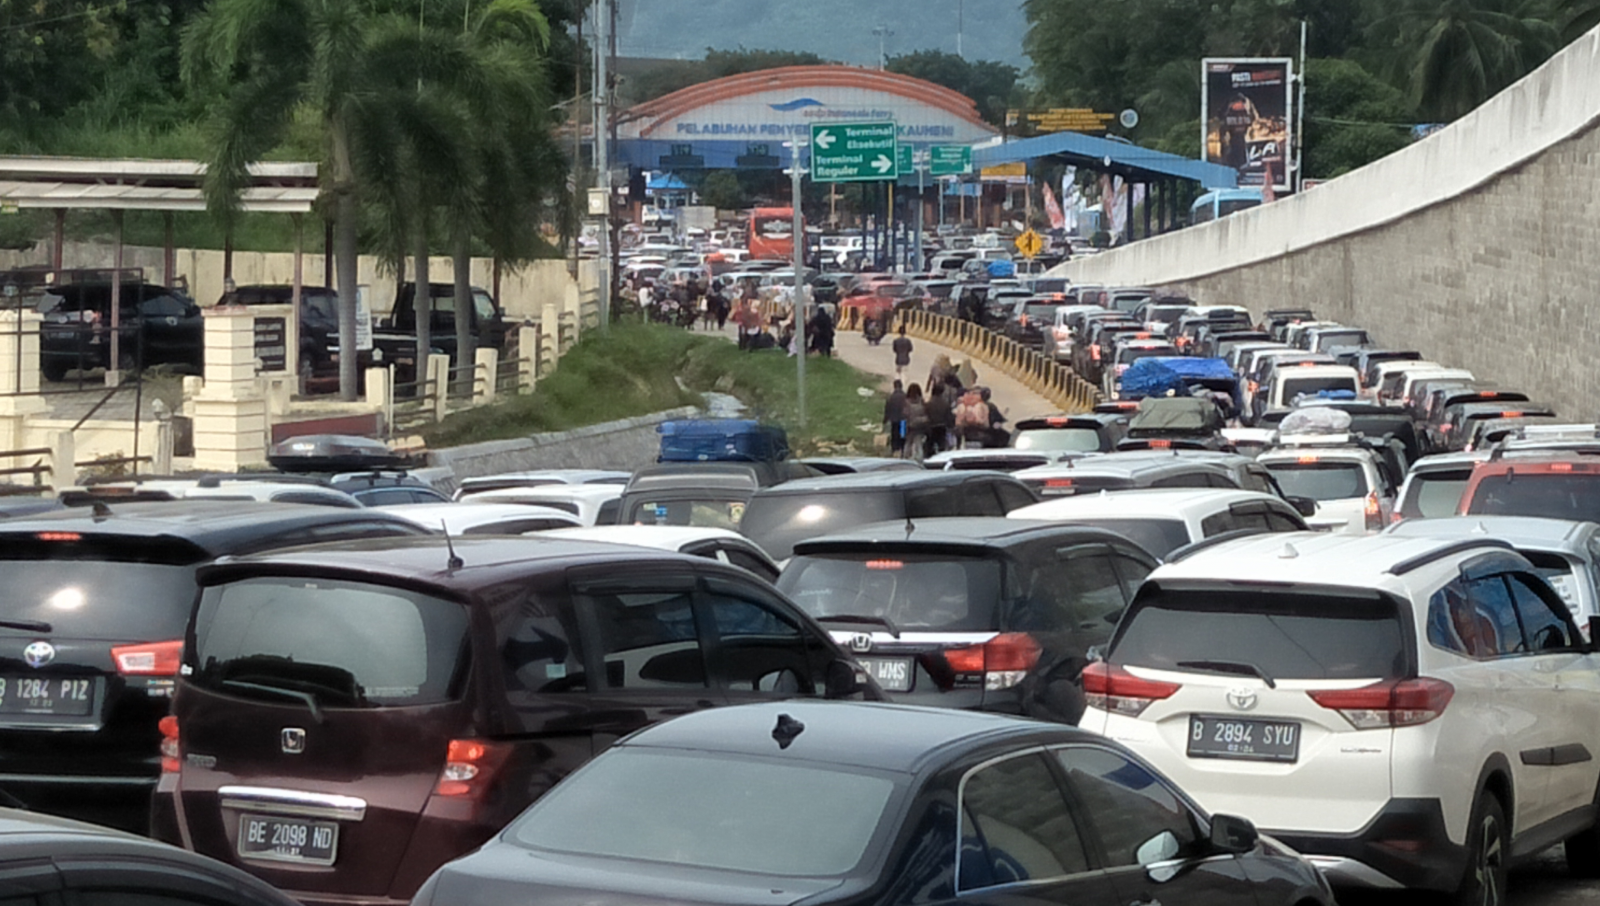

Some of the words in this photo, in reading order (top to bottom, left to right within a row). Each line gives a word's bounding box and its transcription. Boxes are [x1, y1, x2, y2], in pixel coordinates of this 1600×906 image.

[676, 123, 757, 135] PELABUHAN
[760, 124, 810, 136] PENYEB
[896, 124, 955, 137] KAUHENI
[845, 126, 893, 137] Terminal
[847, 139, 893, 149] Eksekutif
[816, 154, 863, 165] Terminal
[817, 165, 859, 178] Reguler
[878, 661, 906, 680] WMS
[17, 679, 50, 699] 1284
[60, 680, 89, 700] PIZ
[1192, 721, 1204, 741] B
[1214, 723, 1253, 743] 2894
[1263, 725, 1294, 745] SYU
[248, 821, 267, 843] BE
[271, 823, 307, 846] 2098
[313, 826, 331, 849] ND
